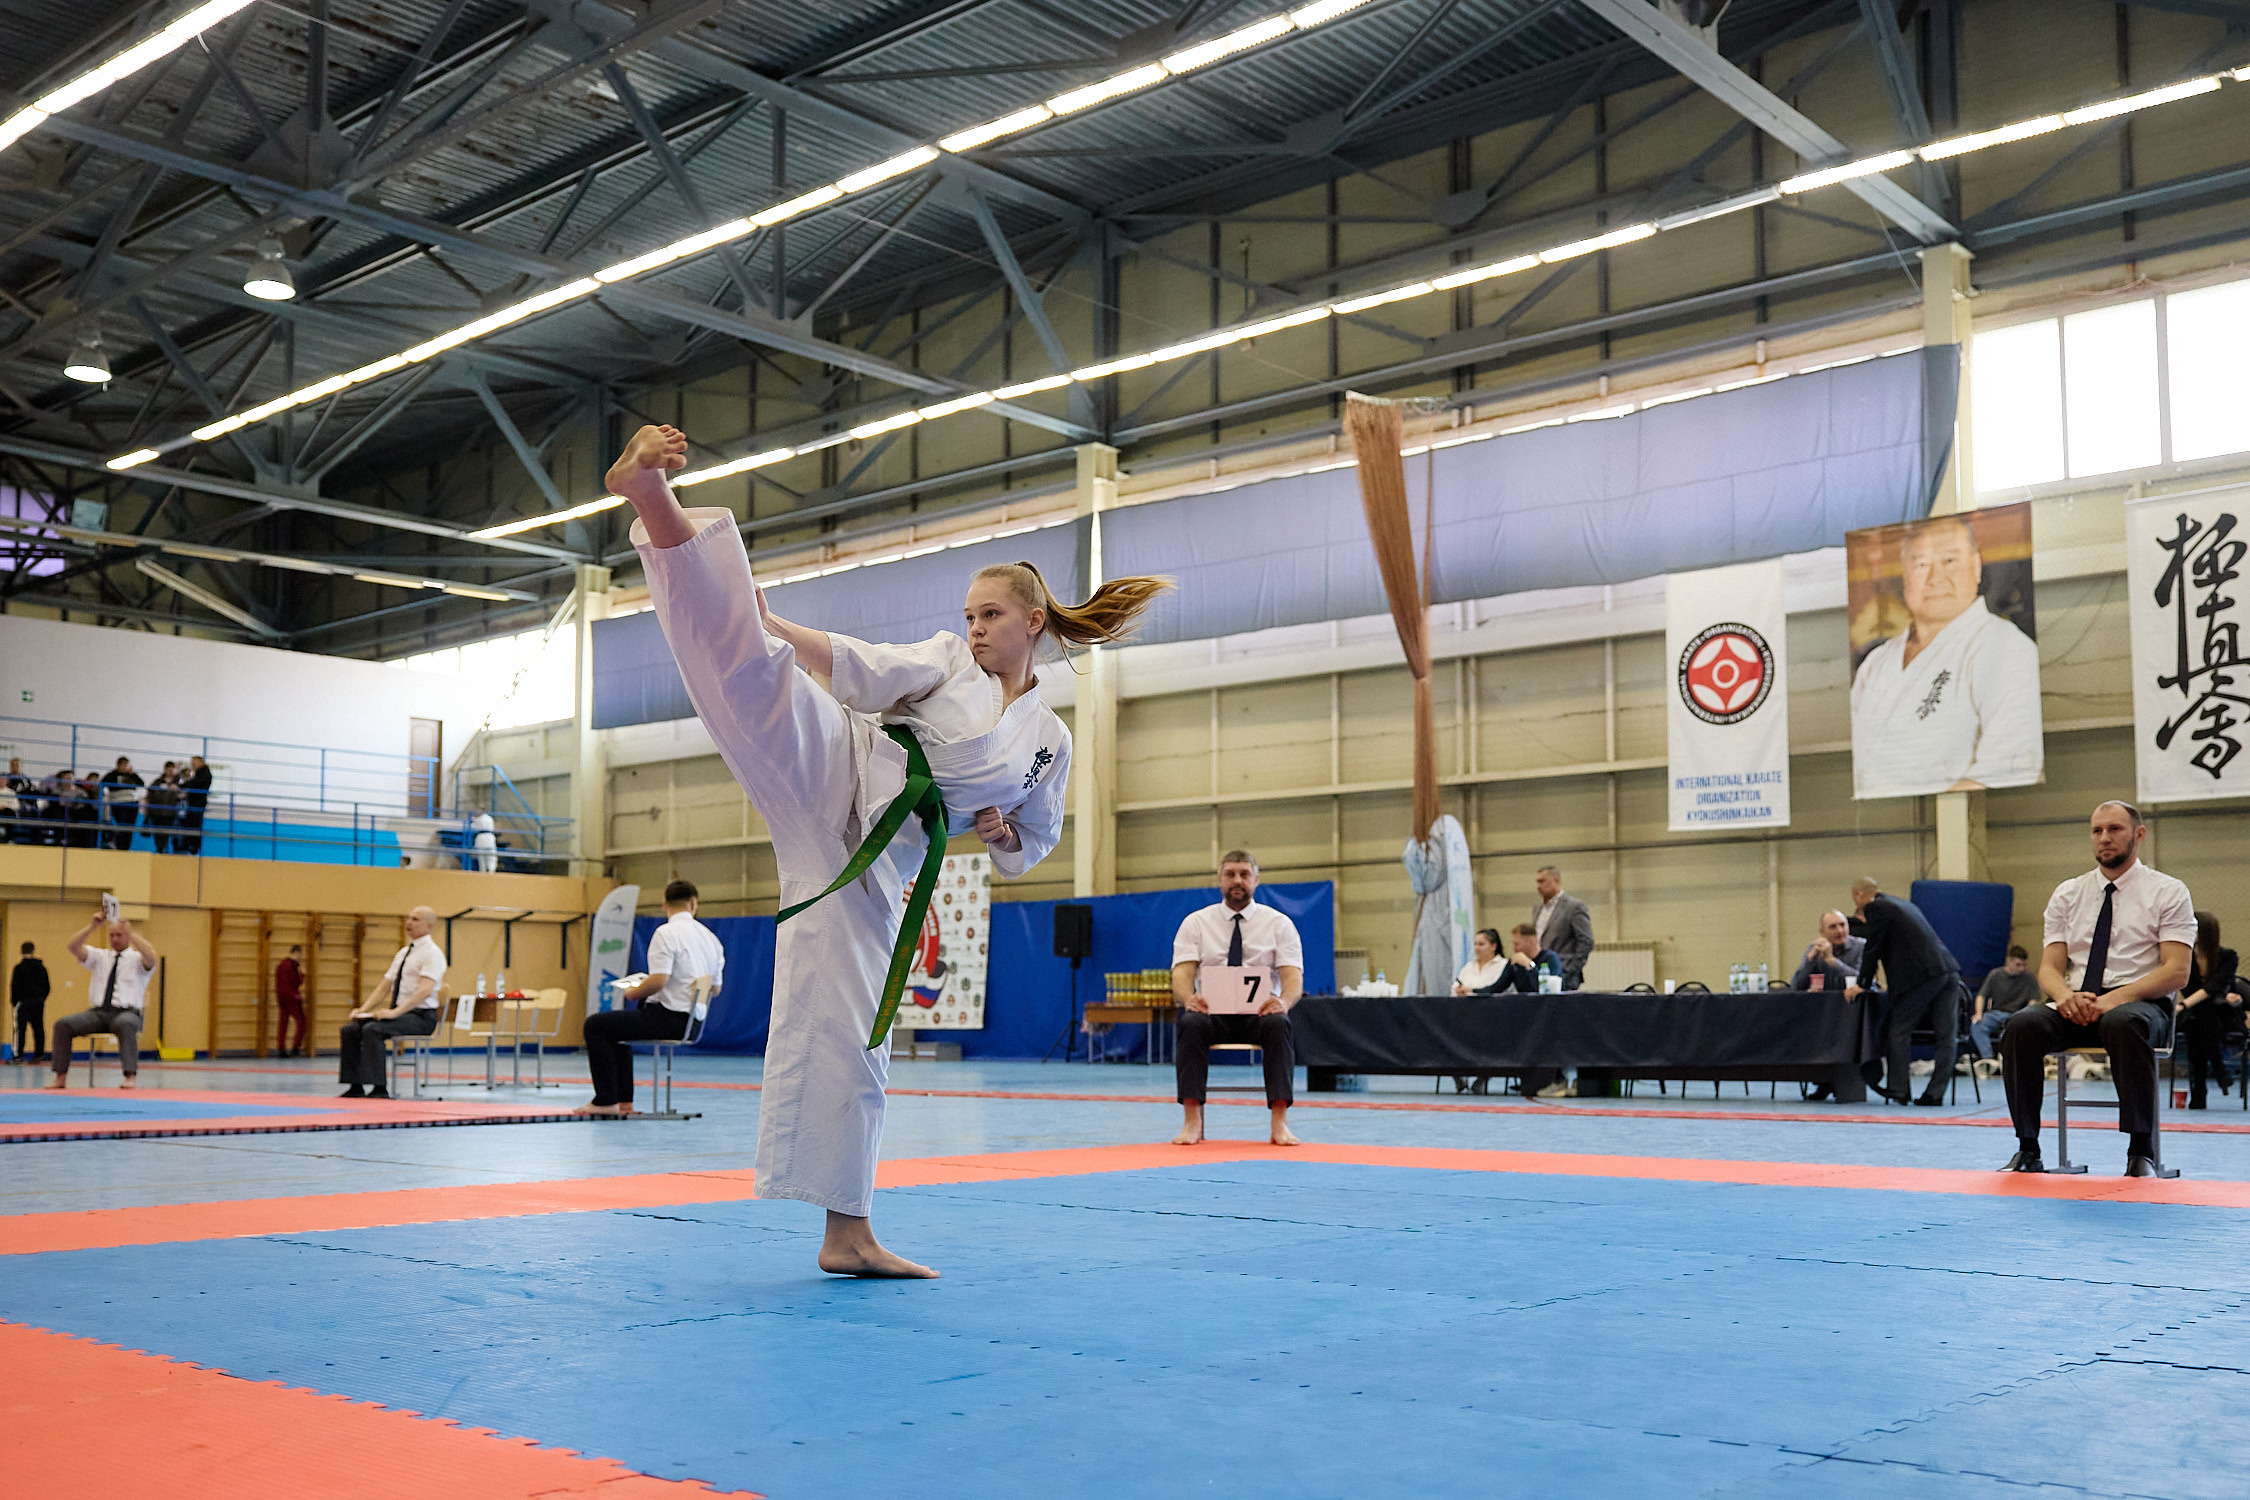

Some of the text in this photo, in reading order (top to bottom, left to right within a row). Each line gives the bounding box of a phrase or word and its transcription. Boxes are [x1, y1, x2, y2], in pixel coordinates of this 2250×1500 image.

[1675, 770, 1782, 789] INTERNATIONAL KARATE
[1696, 790, 1761, 805] ORGANIZATION
[1686, 806, 1772, 821] KYOKUSHINKAIKAN
[1243, 976, 1261, 1003] 7
